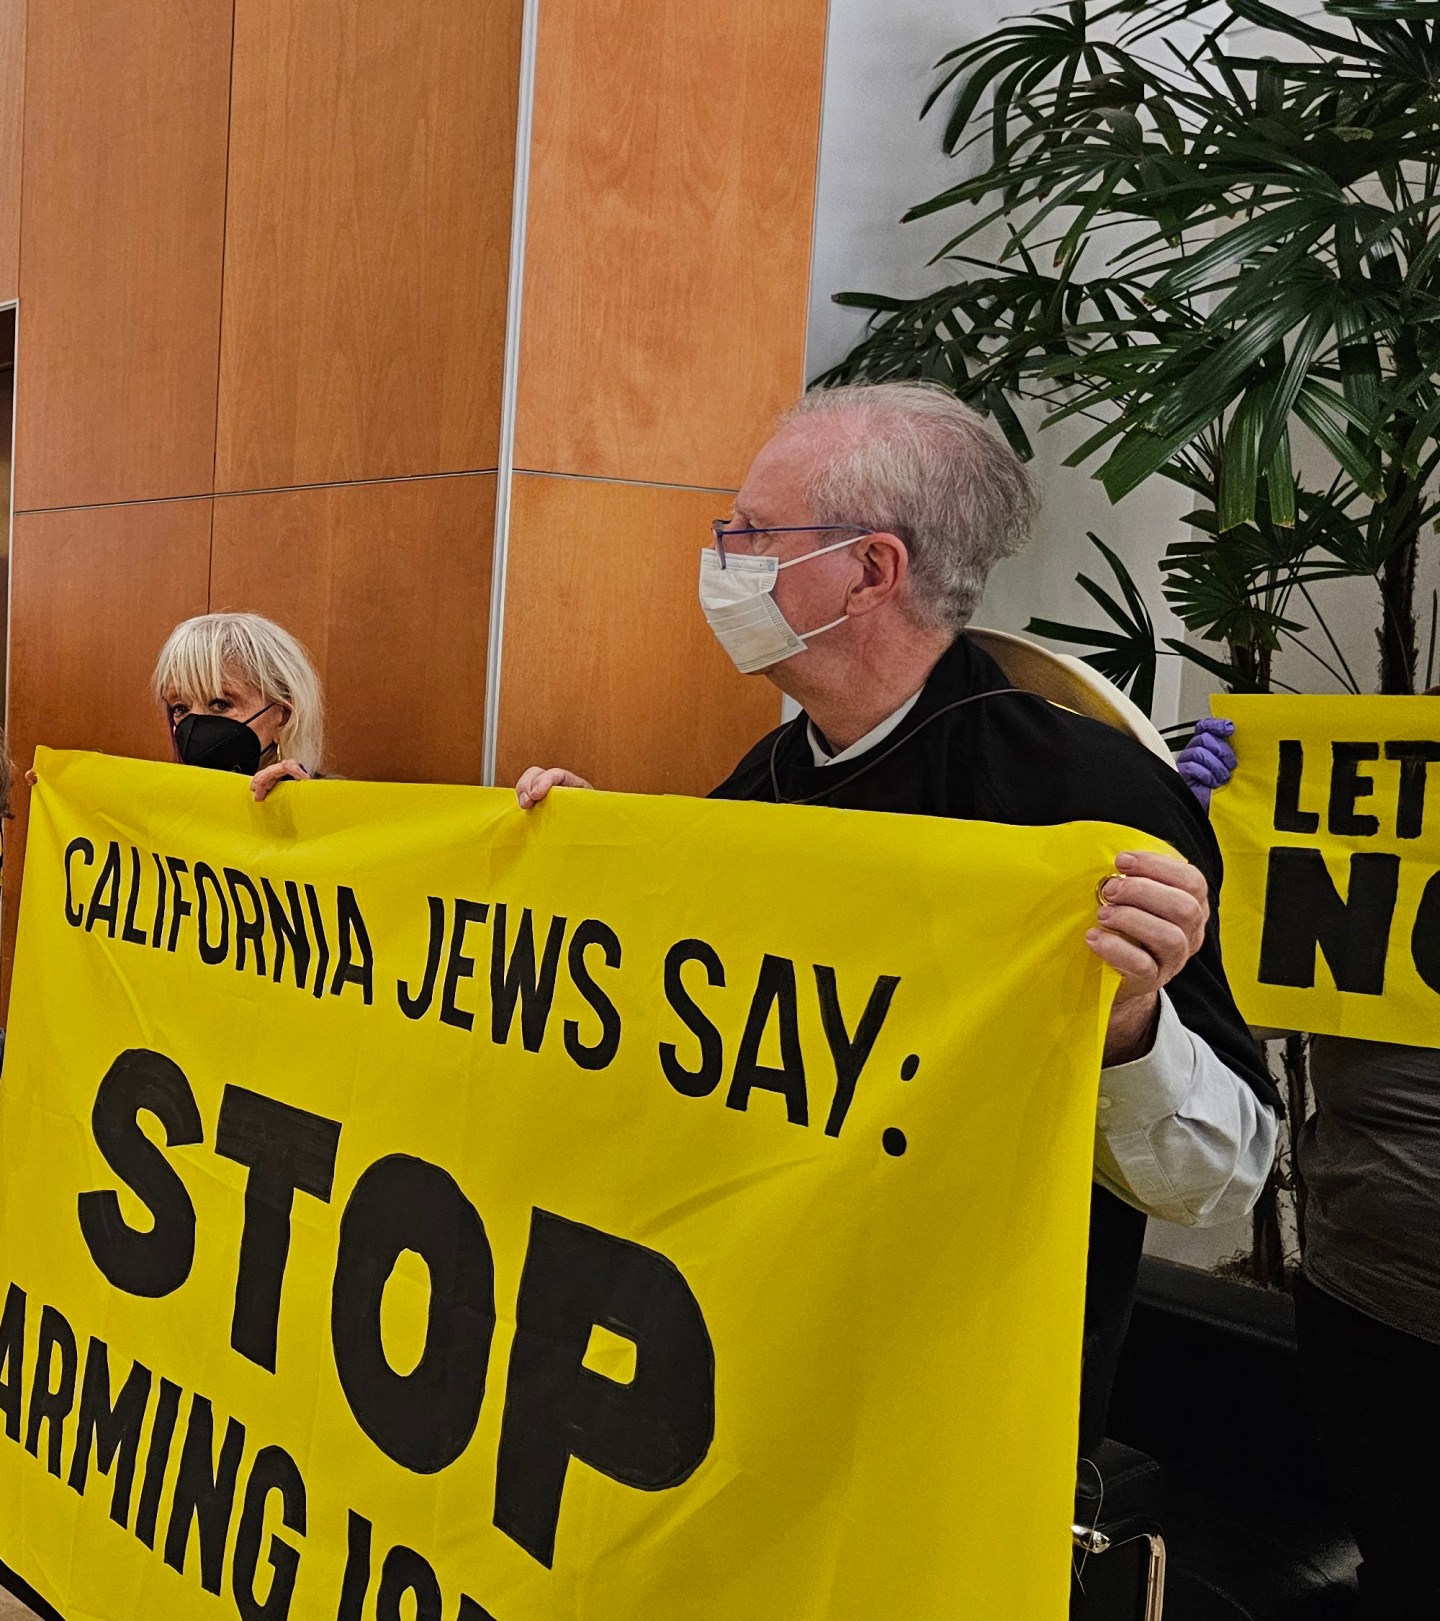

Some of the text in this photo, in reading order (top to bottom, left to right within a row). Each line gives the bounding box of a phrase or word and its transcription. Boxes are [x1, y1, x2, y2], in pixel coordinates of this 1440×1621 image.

[63, 835, 375, 1007] CALIFORNIA
[397, 894, 622, 1071] JEWS
[659, 937, 923, 1158] SAY:
[77, 1047, 717, 1571] STOP
